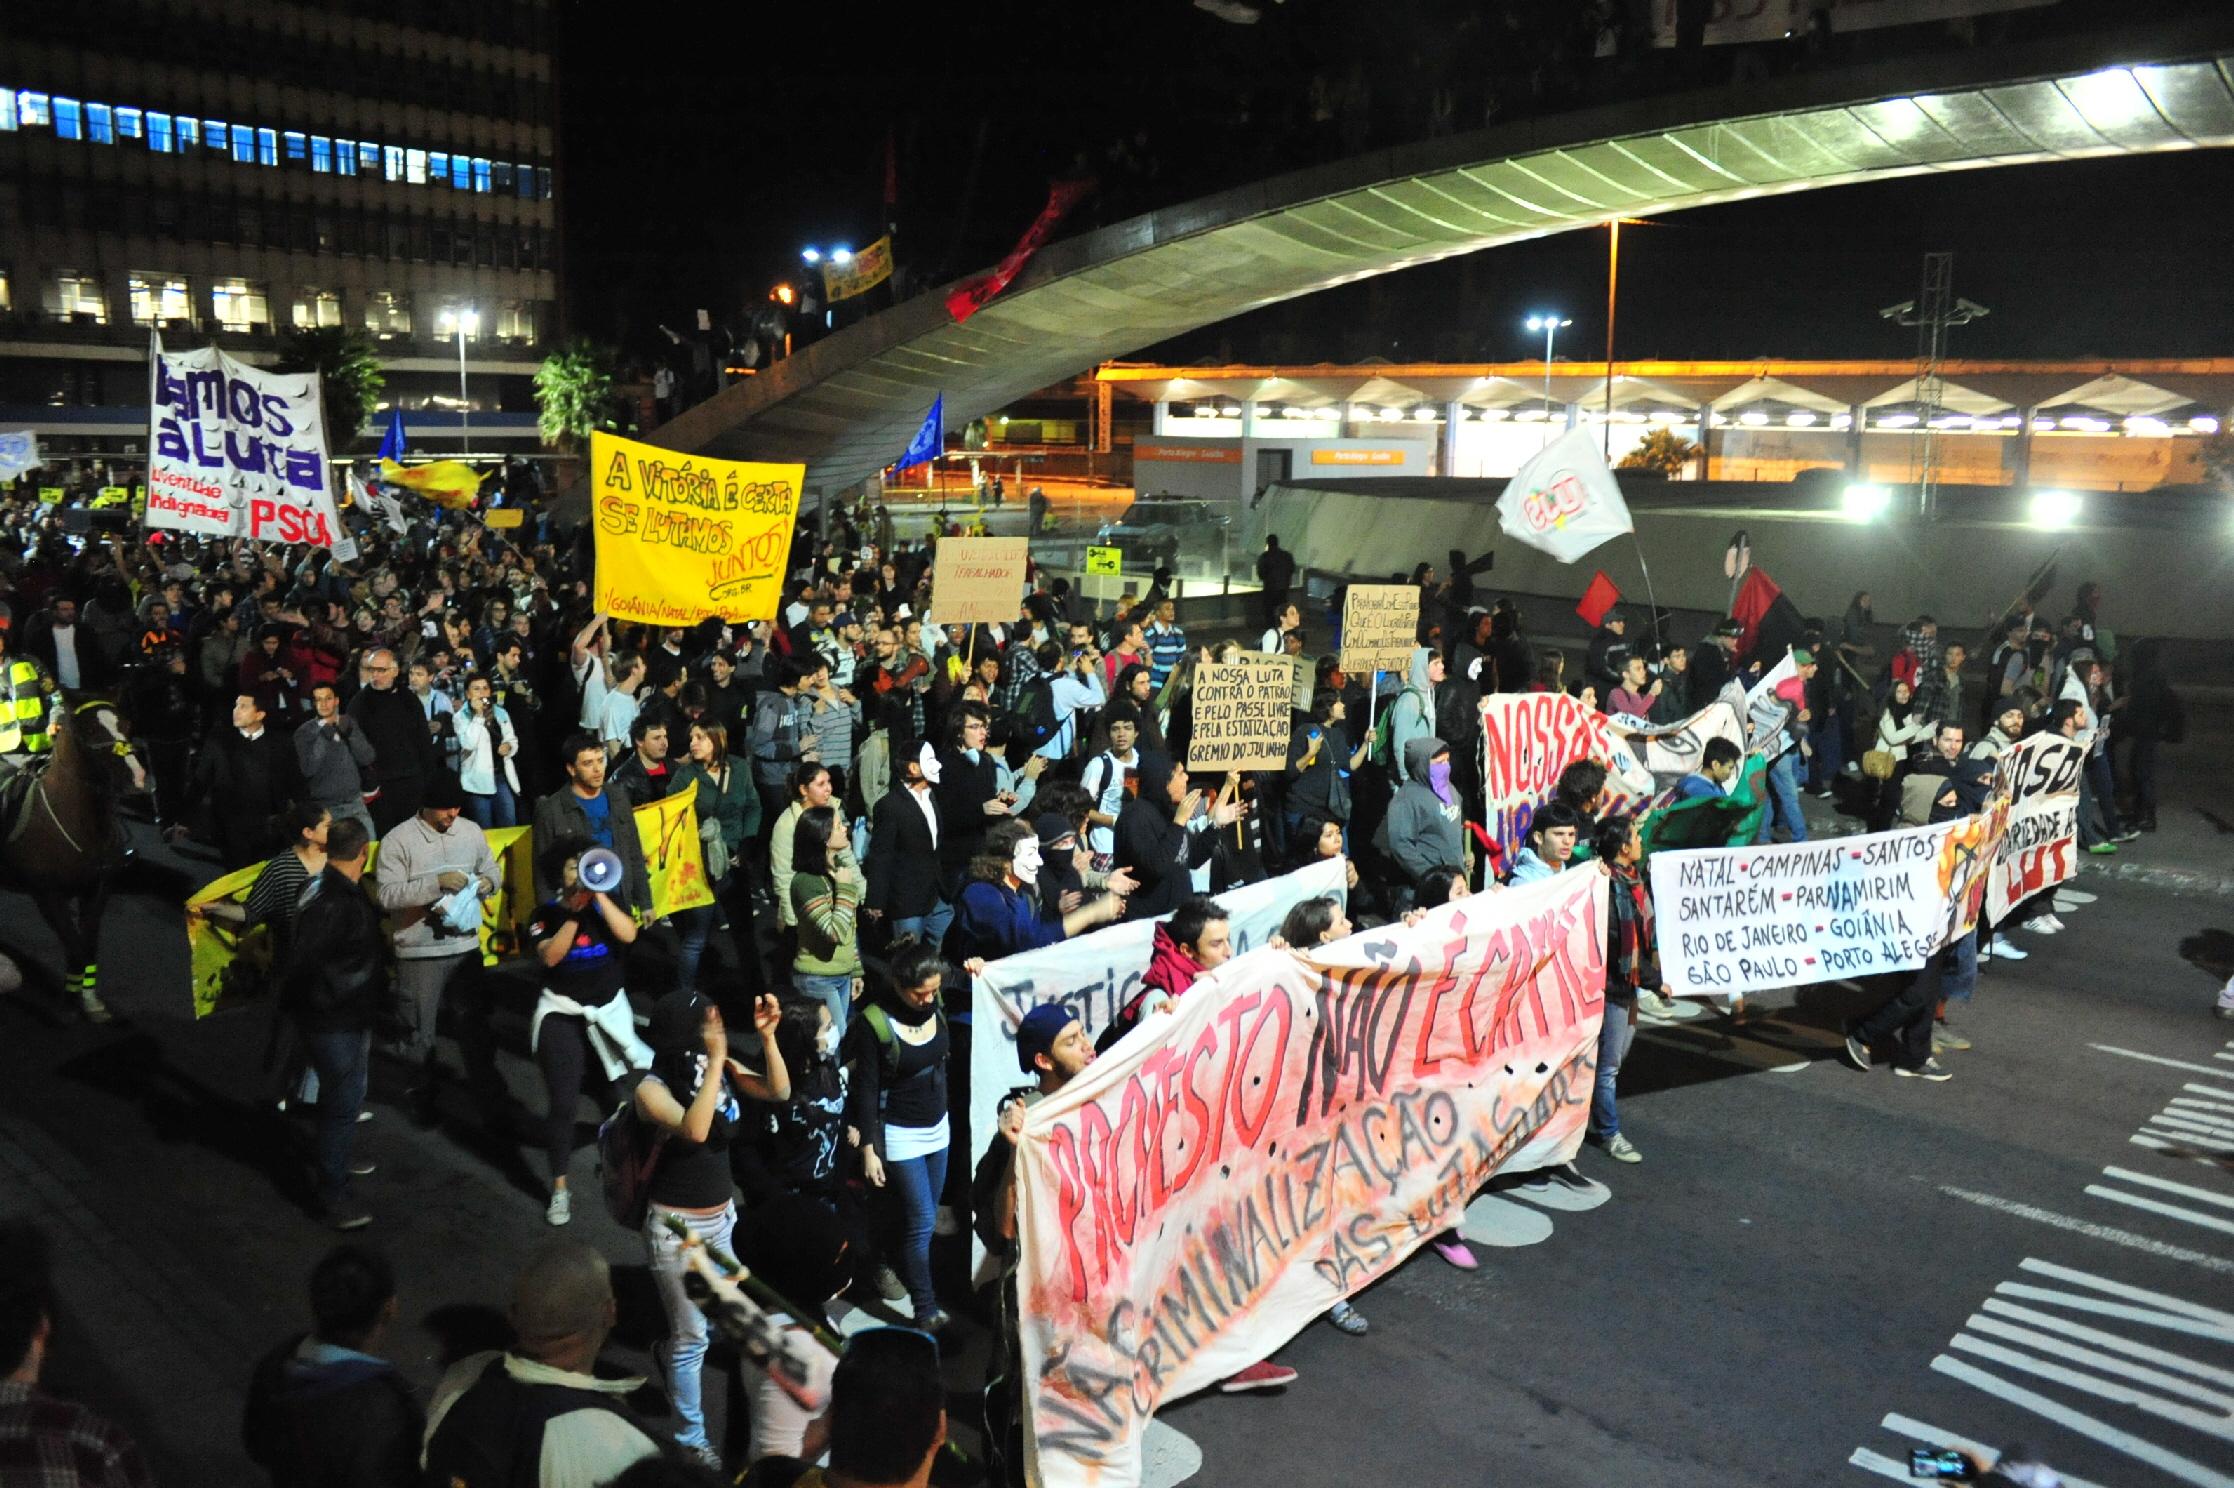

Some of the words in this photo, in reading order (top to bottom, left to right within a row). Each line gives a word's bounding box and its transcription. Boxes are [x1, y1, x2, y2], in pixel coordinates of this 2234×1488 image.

[605, 450, 631, 490] A
[724, 469, 740, 511] É
[741, 480, 793, 516] CERTA
[600, 496, 640, 535] SE
[641, 507, 733, 555] LUTAMOS
[1198, 670, 1206, 684] A
[1212, 668, 1249, 686] NOSSA
[1256, 668, 1285, 684] LUTA
[1247, 684, 1254, 699] O
[1193, 724, 1198, 740] E
[1200, 722, 1222, 738] PELA
[1195, 706, 1201, 720] E
[1205, 704, 1231, 720] PELO
[1235, 701, 1265, 718] PASSE
[1267, 701, 1290, 718] LIVRE
[1232, 743, 1246, 761] DO
[1247, 741, 1287, 758] JULINHO
[1680, 857, 1736, 889] NATAL
[1749, 847, 1845, 880] CAMPINAS
[1863, 833, 1938, 866] SANTOS
[1679, 884, 1777, 922] SANTARÉM
[1796, 872, 1915, 914] PARNAMIRIM
[1682, 933, 1709, 958] RIO
[1715, 929, 1737, 951] DE
[1741, 923, 1808, 951] JANEIRO
[1830, 909, 1913, 939] GOIÂNIA
[1687, 961, 1732, 986] SÃO
[1741, 956, 1798, 982] PAULO
[1820, 946, 1873, 973] PORTO
[1048, 984, 1293, 1303] PROTESTO
[1296, 938, 1420, 1128] NÃO
[1411, 909, 1469, 1080] É
[1313, 1212, 1394, 1292] DAS
